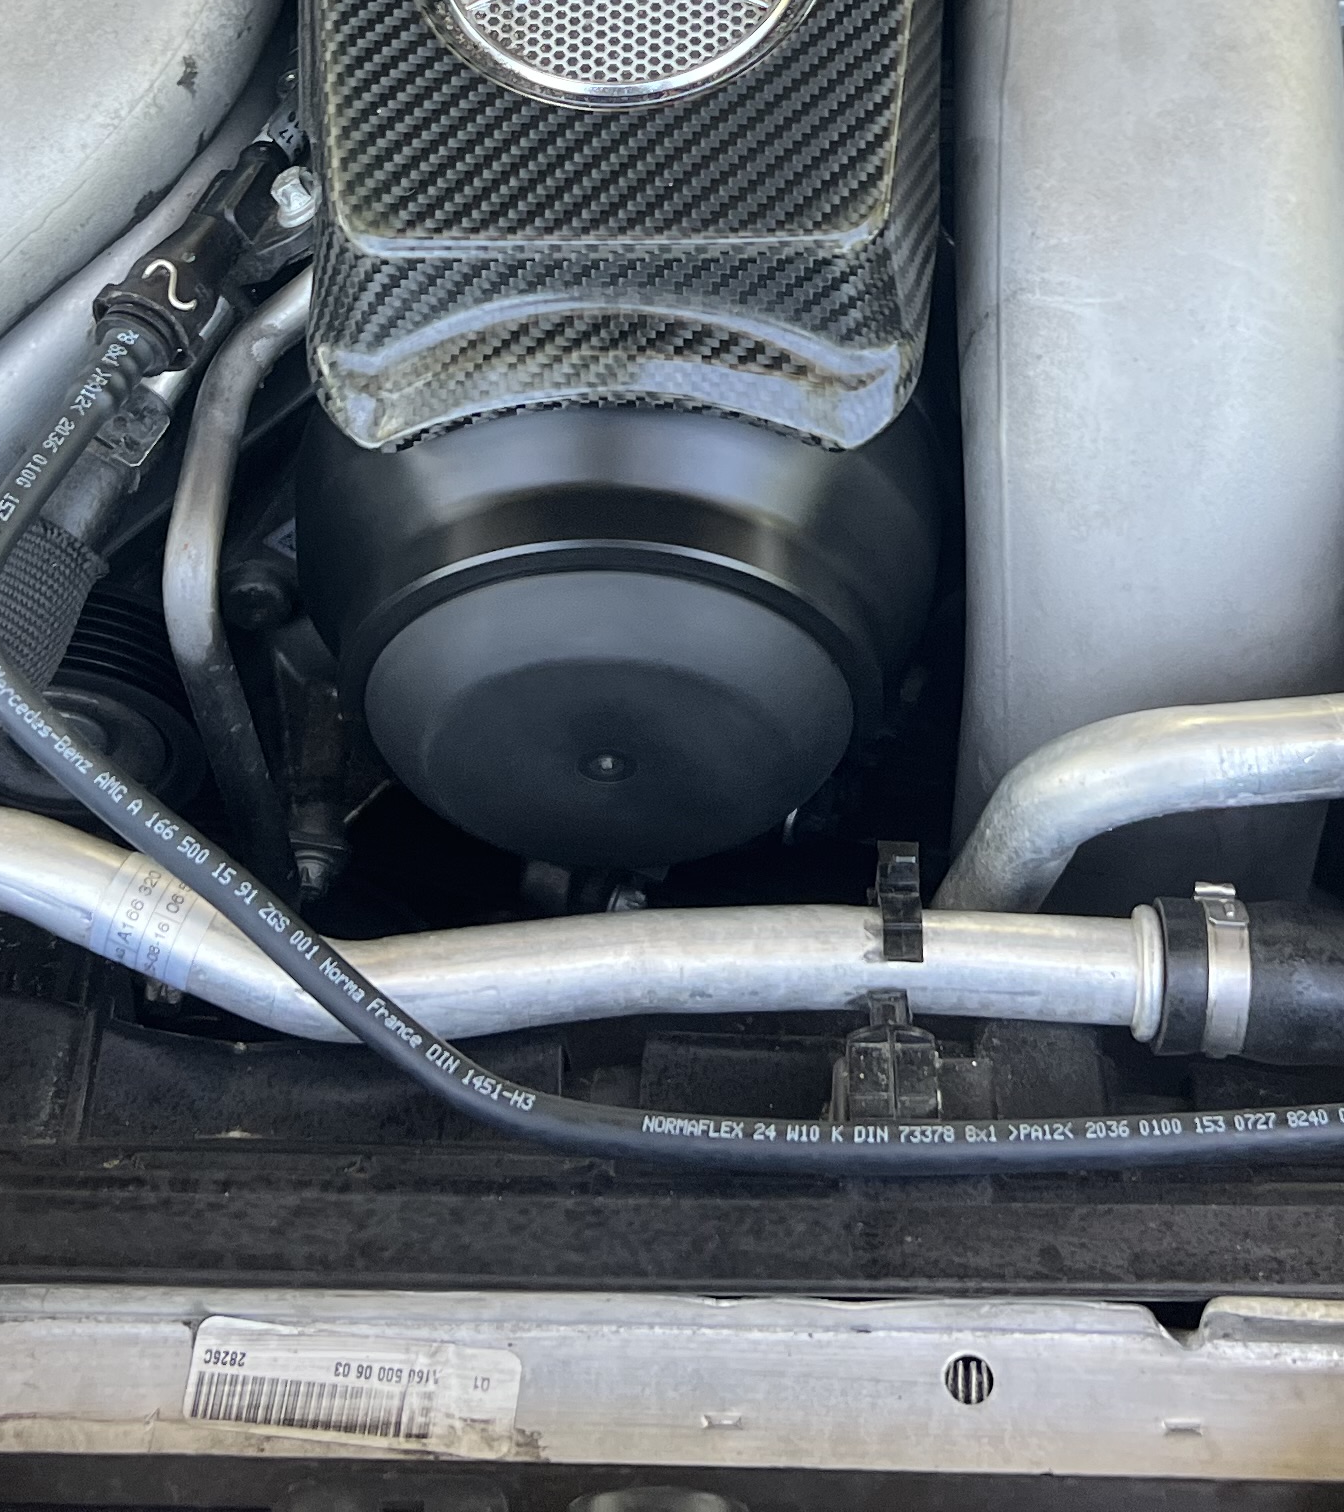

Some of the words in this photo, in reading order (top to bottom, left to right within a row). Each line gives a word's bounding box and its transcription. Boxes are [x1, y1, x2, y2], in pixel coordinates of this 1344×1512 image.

[43, 416, 75, 453] 2036
[94, 771, 129, 803] AMG
[127, 798, 143, 815] A
[145, 811, 179, 840] 166
[176, 835, 210, 865] 500
[211, 862, 237, 885] 15
[234, 881, 258, 904] 91
[258, 901, 291, 933] ZGS
[289, 929, 320, 961] 001
[318, 957, 366, 1003] Norma
[366, 997, 423, 1049] France
[425, 1042, 461, 1075] DIN
[461, 1068, 537, 1112] 1451-H3
[116, 898, 145, 945] A166
[139, 870, 162, 896] 320
[166, 893, 185, 914] 06
[642, 1114, 745, 1141] NORMAFLEX
[752, 1125, 776, 1143] 24
[785, 1126, 820, 1144] W10
[831, 1125, 844, 1143] K
[854, 1125, 889, 1144] DIN
[899, 1125, 955, 1143] 73378
[965, 1125, 998, 1143] 8x1
[1008, 1123, 1074, 1143] >PA12<
[1086, 1119, 1130, 1139] 2036
[1139, 1118, 1182, 1136] 0100
[1194, 1114, 1226, 1134] 153
[1234, 1111, 1276, 1131] 0727
[1287, 1108, 1328, 1128] 8240
[203, 1349, 246, 1367] 2826C
[333, 1361, 352, 1378] 03
[356, 1364, 374, 1381] 06
[378, 1366, 403, 1383] 500
